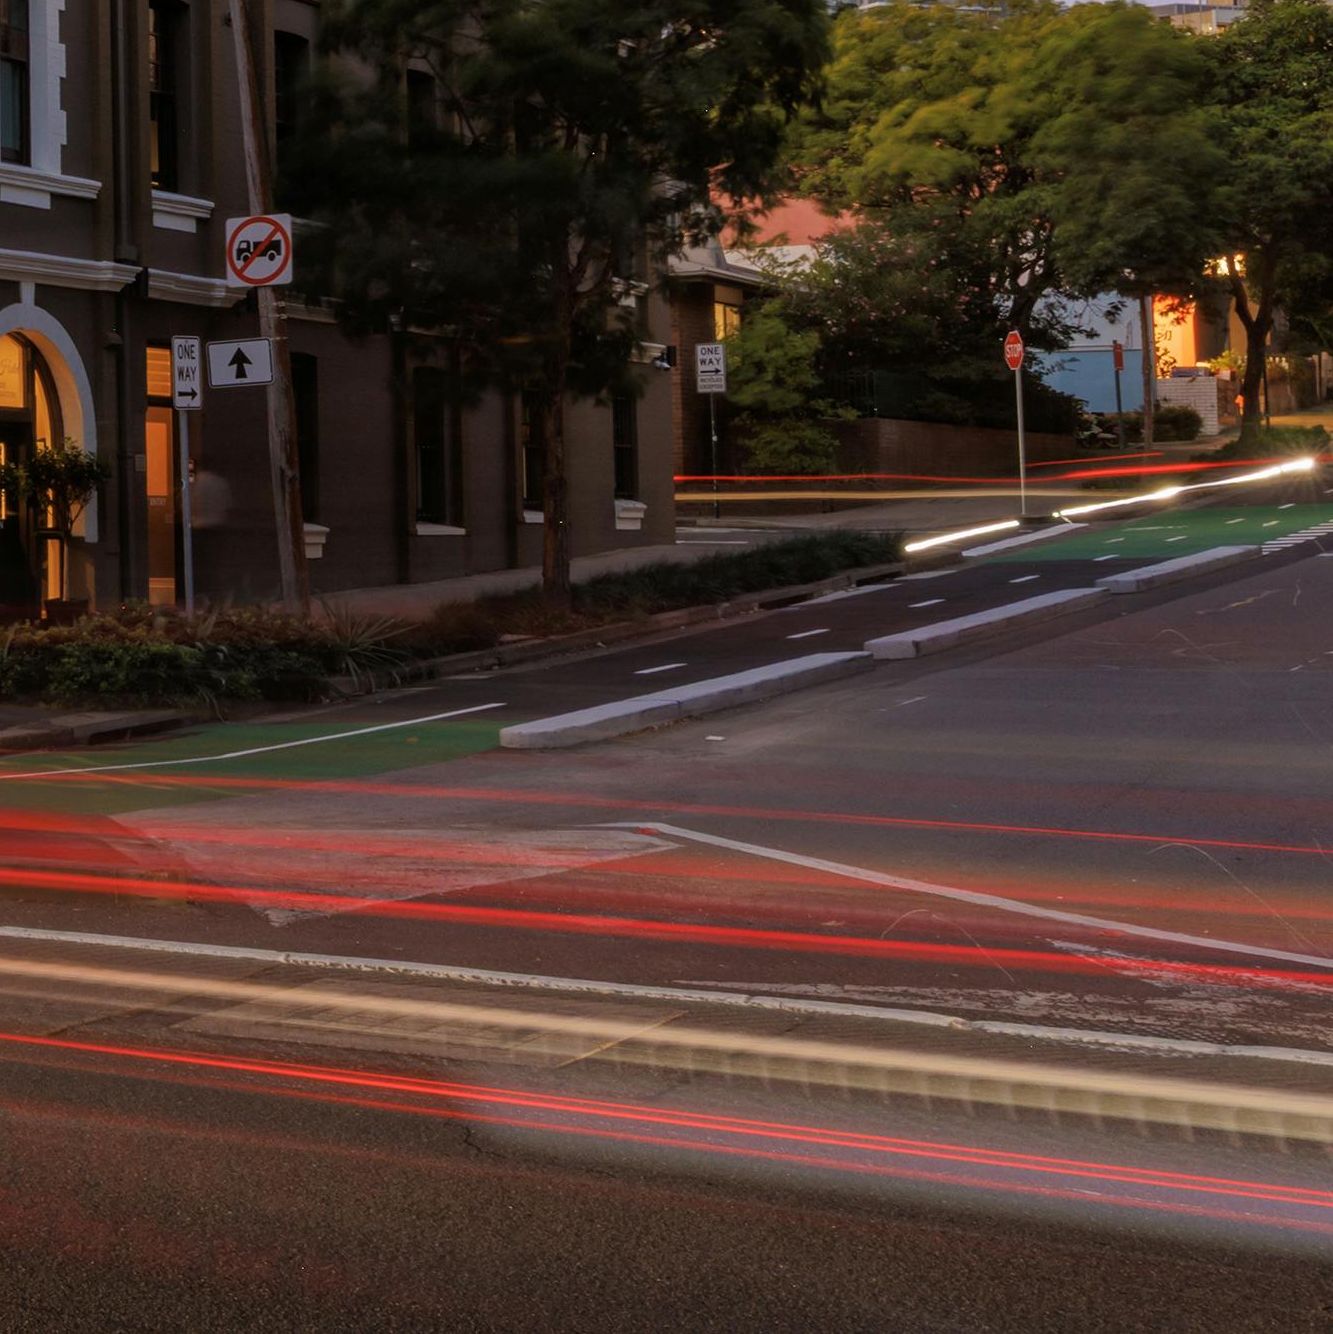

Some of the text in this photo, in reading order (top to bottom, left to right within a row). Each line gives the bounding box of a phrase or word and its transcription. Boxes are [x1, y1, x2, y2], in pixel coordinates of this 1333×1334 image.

[177, 344, 196, 360] ONE
[700, 347, 721, 356] ONE
[1005, 343, 1022, 358] STOP
[700, 357, 721, 366] WAY
[177, 366, 197, 382] WAY
